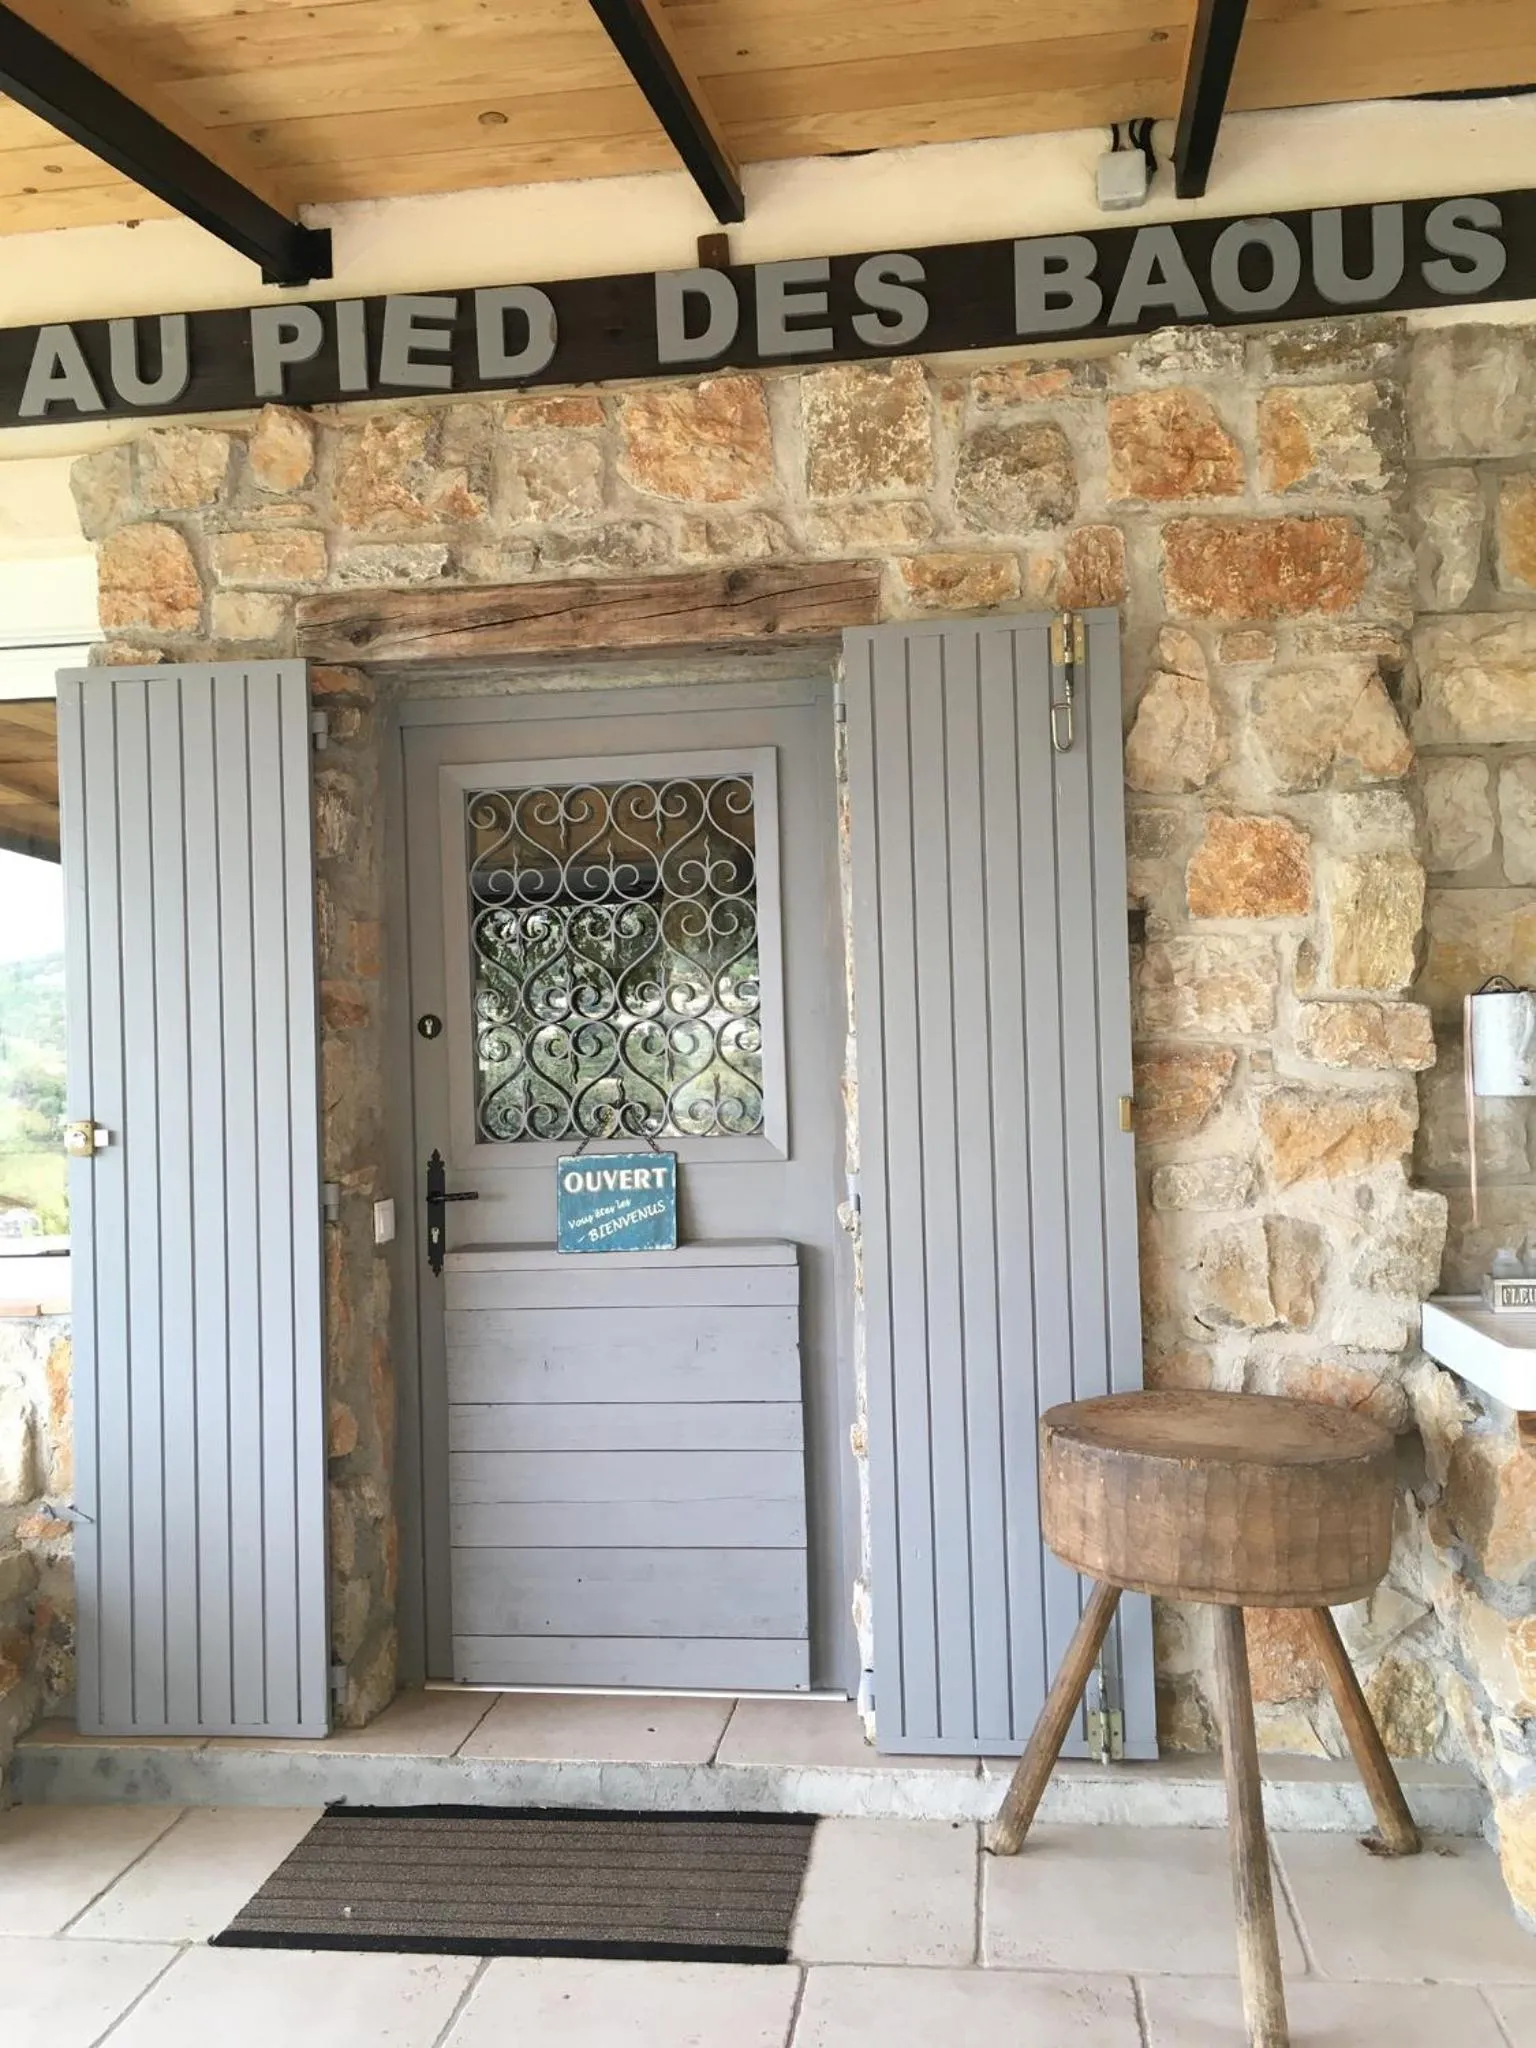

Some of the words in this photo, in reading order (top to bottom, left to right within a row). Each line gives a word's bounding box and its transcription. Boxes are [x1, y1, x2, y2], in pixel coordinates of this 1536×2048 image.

[18, 314, 190, 417] AU
[250, 285, 558, 397] PIED
[654, 252, 929, 365] DES
[1013, 198, 1507, 335] BAOUS
[564, 1167, 667, 1193] OUVERT
[588, 1200, 666, 1242] BIENVENUS
